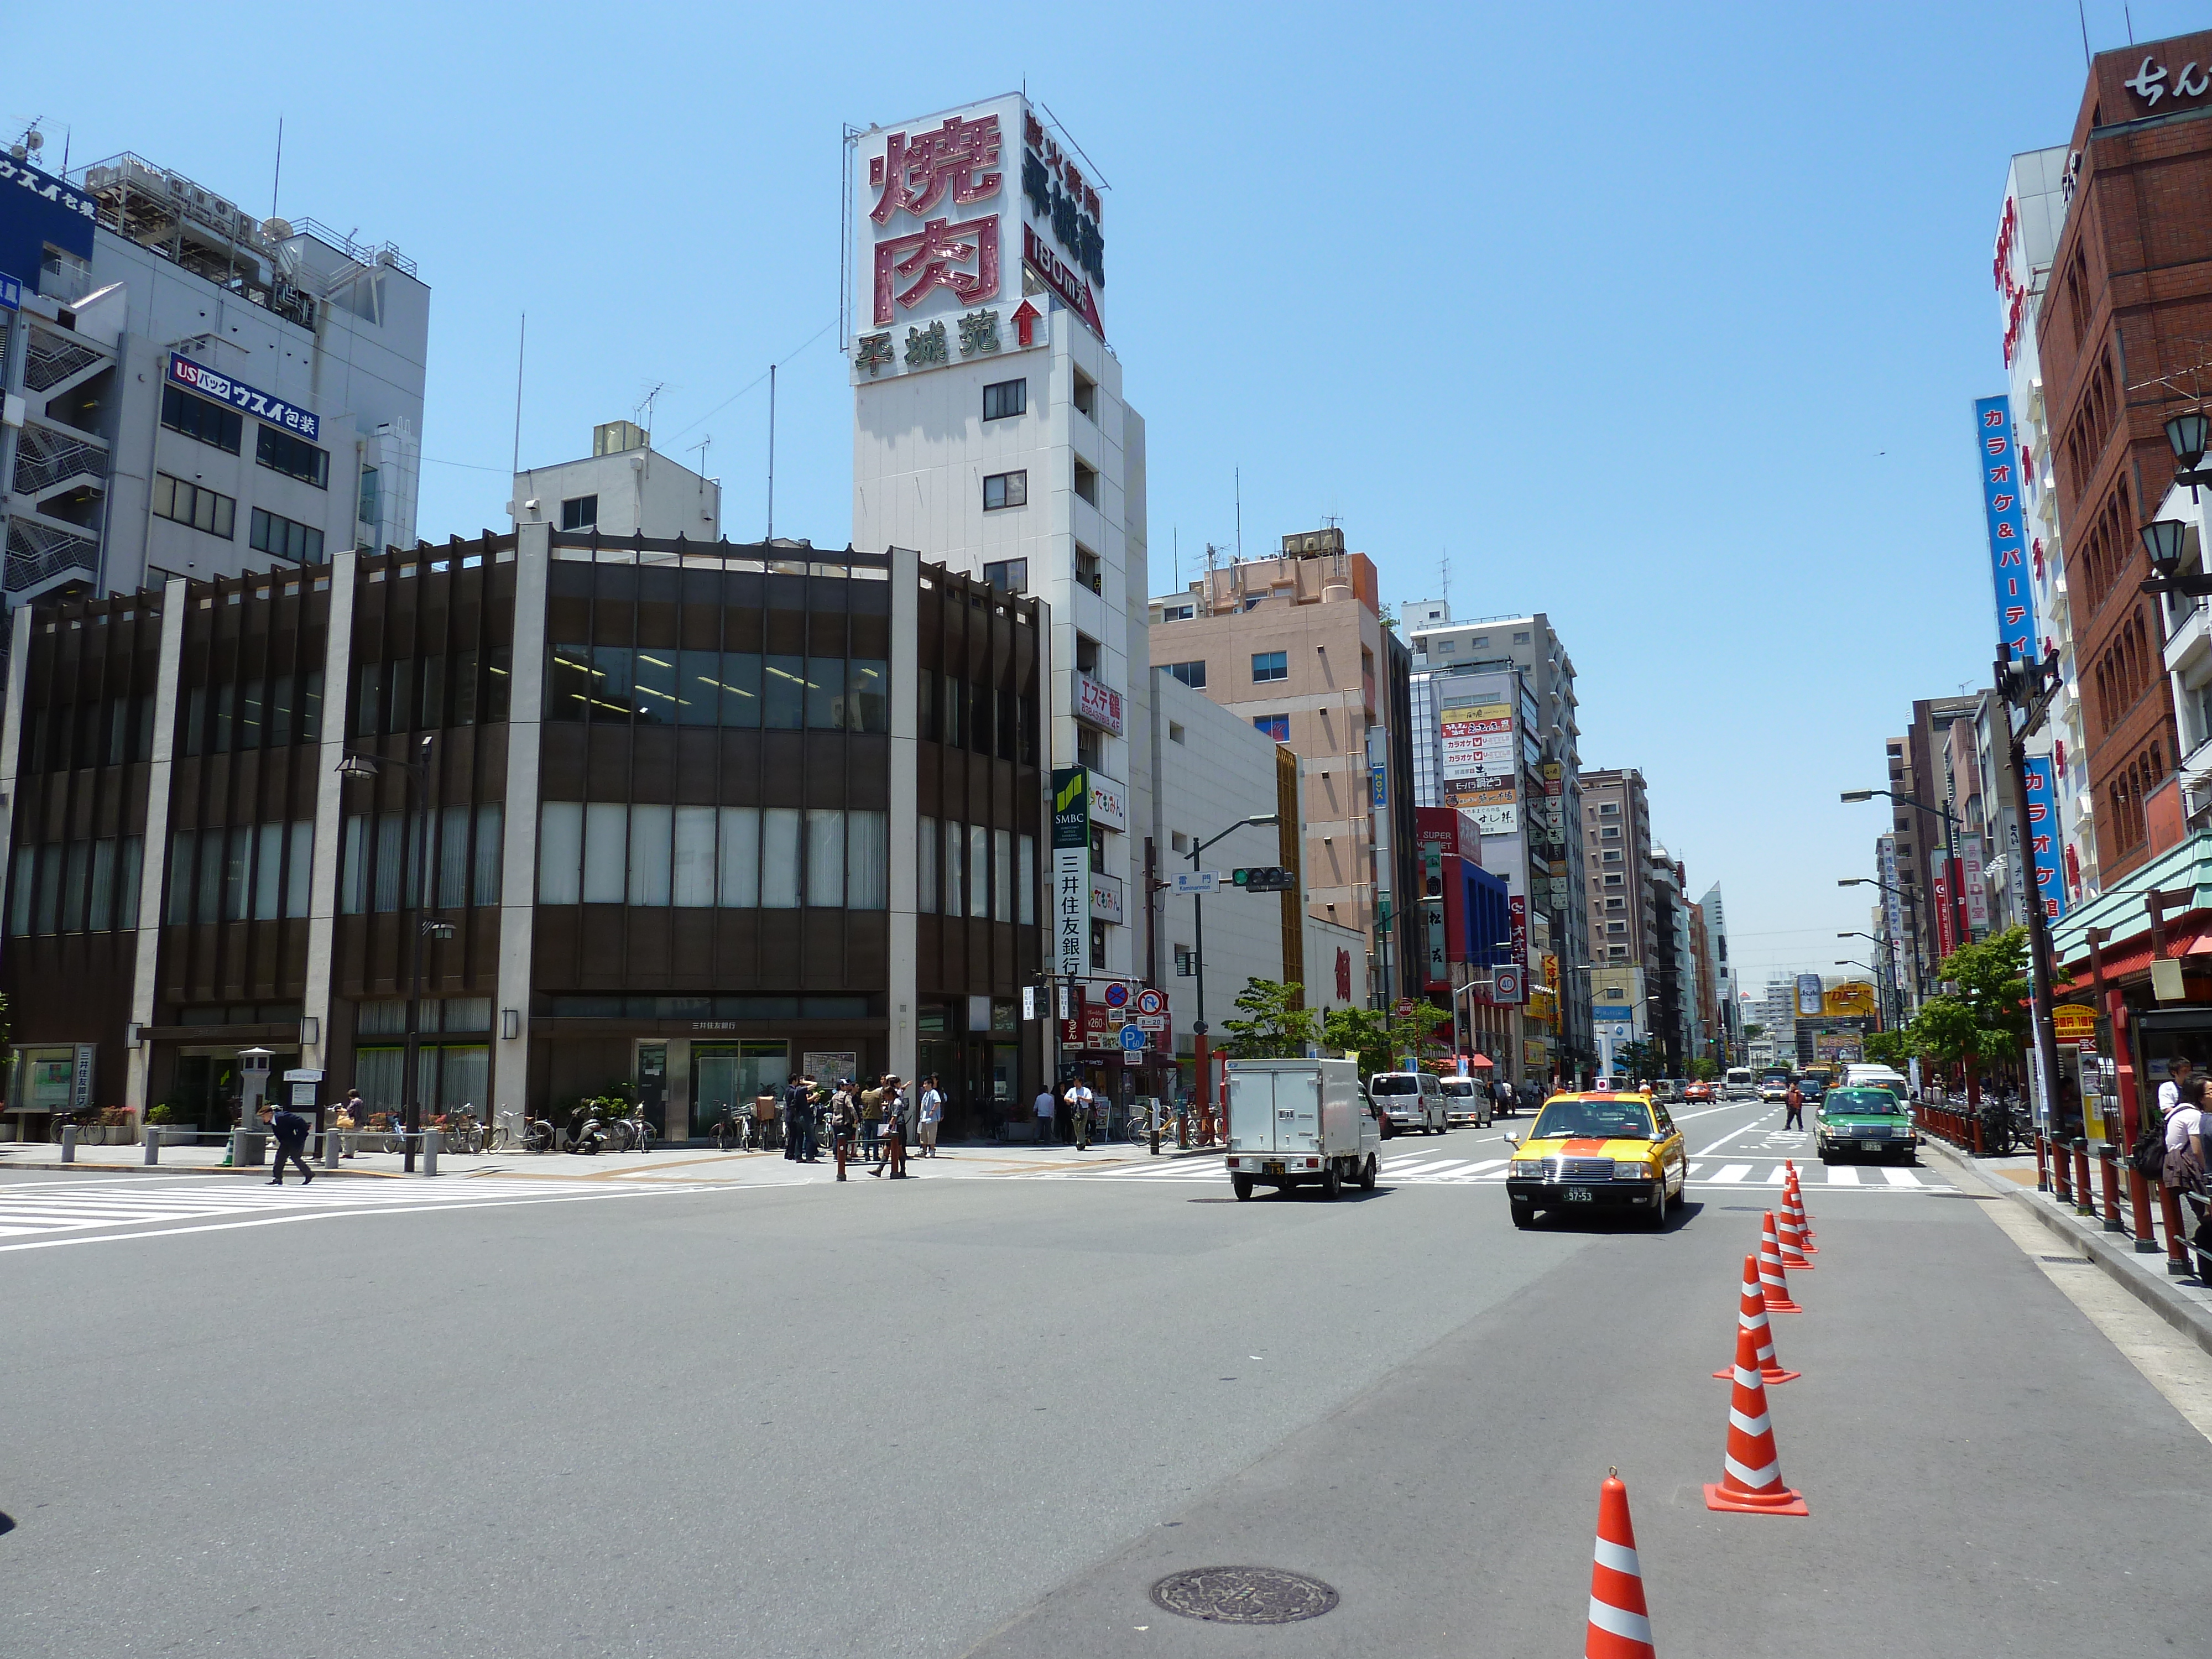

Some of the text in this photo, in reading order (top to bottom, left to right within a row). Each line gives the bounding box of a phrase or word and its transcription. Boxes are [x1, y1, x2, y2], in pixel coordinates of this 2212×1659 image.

[2125, 56, 2212, 107] ちん
[869, 112, 1002, 326] 焼肉
[855, 307, 999, 376] 平城苑
[233, 385, 315, 436] ウスイ包装
[1448, 740, 1472, 749] カラオケ
[1448, 754, 1473, 763] カラオケ
[1375, 773, 1384, 800] NOVA
[1056, 813, 1084, 824] SMBC
[1423, 831, 1452, 839] SUPER
[1417, 841, 1452, 849] MET
[1061, 855, 1081, 977] 三井住友銀行
[1501, 979, 1513, 988] 40
[1125, 1031, 1135, 1048] P
[77, 1052, 90, 1105] 三井住友銀行
[1568, 1192, 1592, 1201] 97-53
